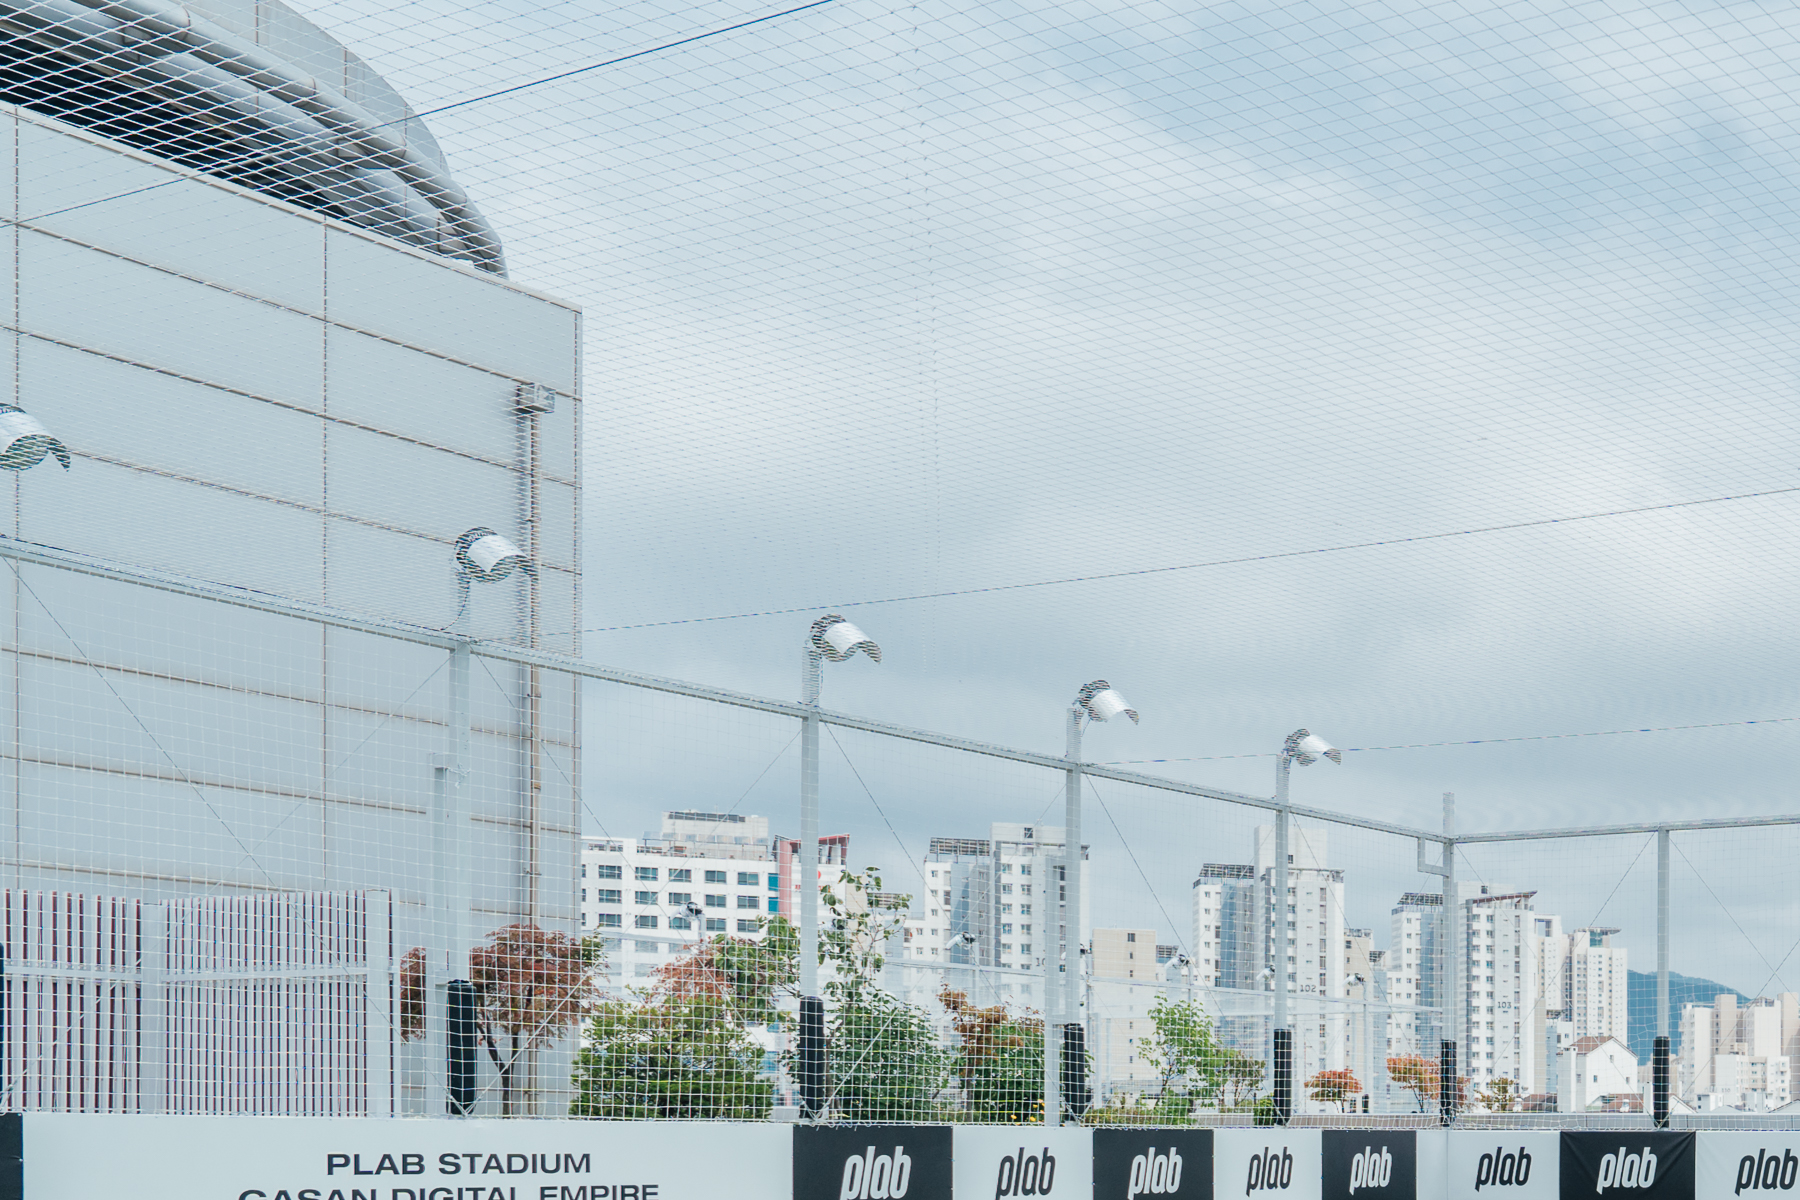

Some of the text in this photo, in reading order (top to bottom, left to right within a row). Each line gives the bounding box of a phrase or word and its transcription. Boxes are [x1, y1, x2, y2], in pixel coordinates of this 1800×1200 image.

[1300, 984, 1317, 993] 102
[1497, 1001, 1512, 1009] 103
[327, 1153, 592, 1176] PLAB STADIUM
[1245, 1146, 1293, 1198] plab
[1348, 1146, 1392, 1196] plab
[1474, 1146, 1532, 1193] plab
[1596, 1147, 1658, 1195] plab
[1735, 1148, 1799, 1197] plab
